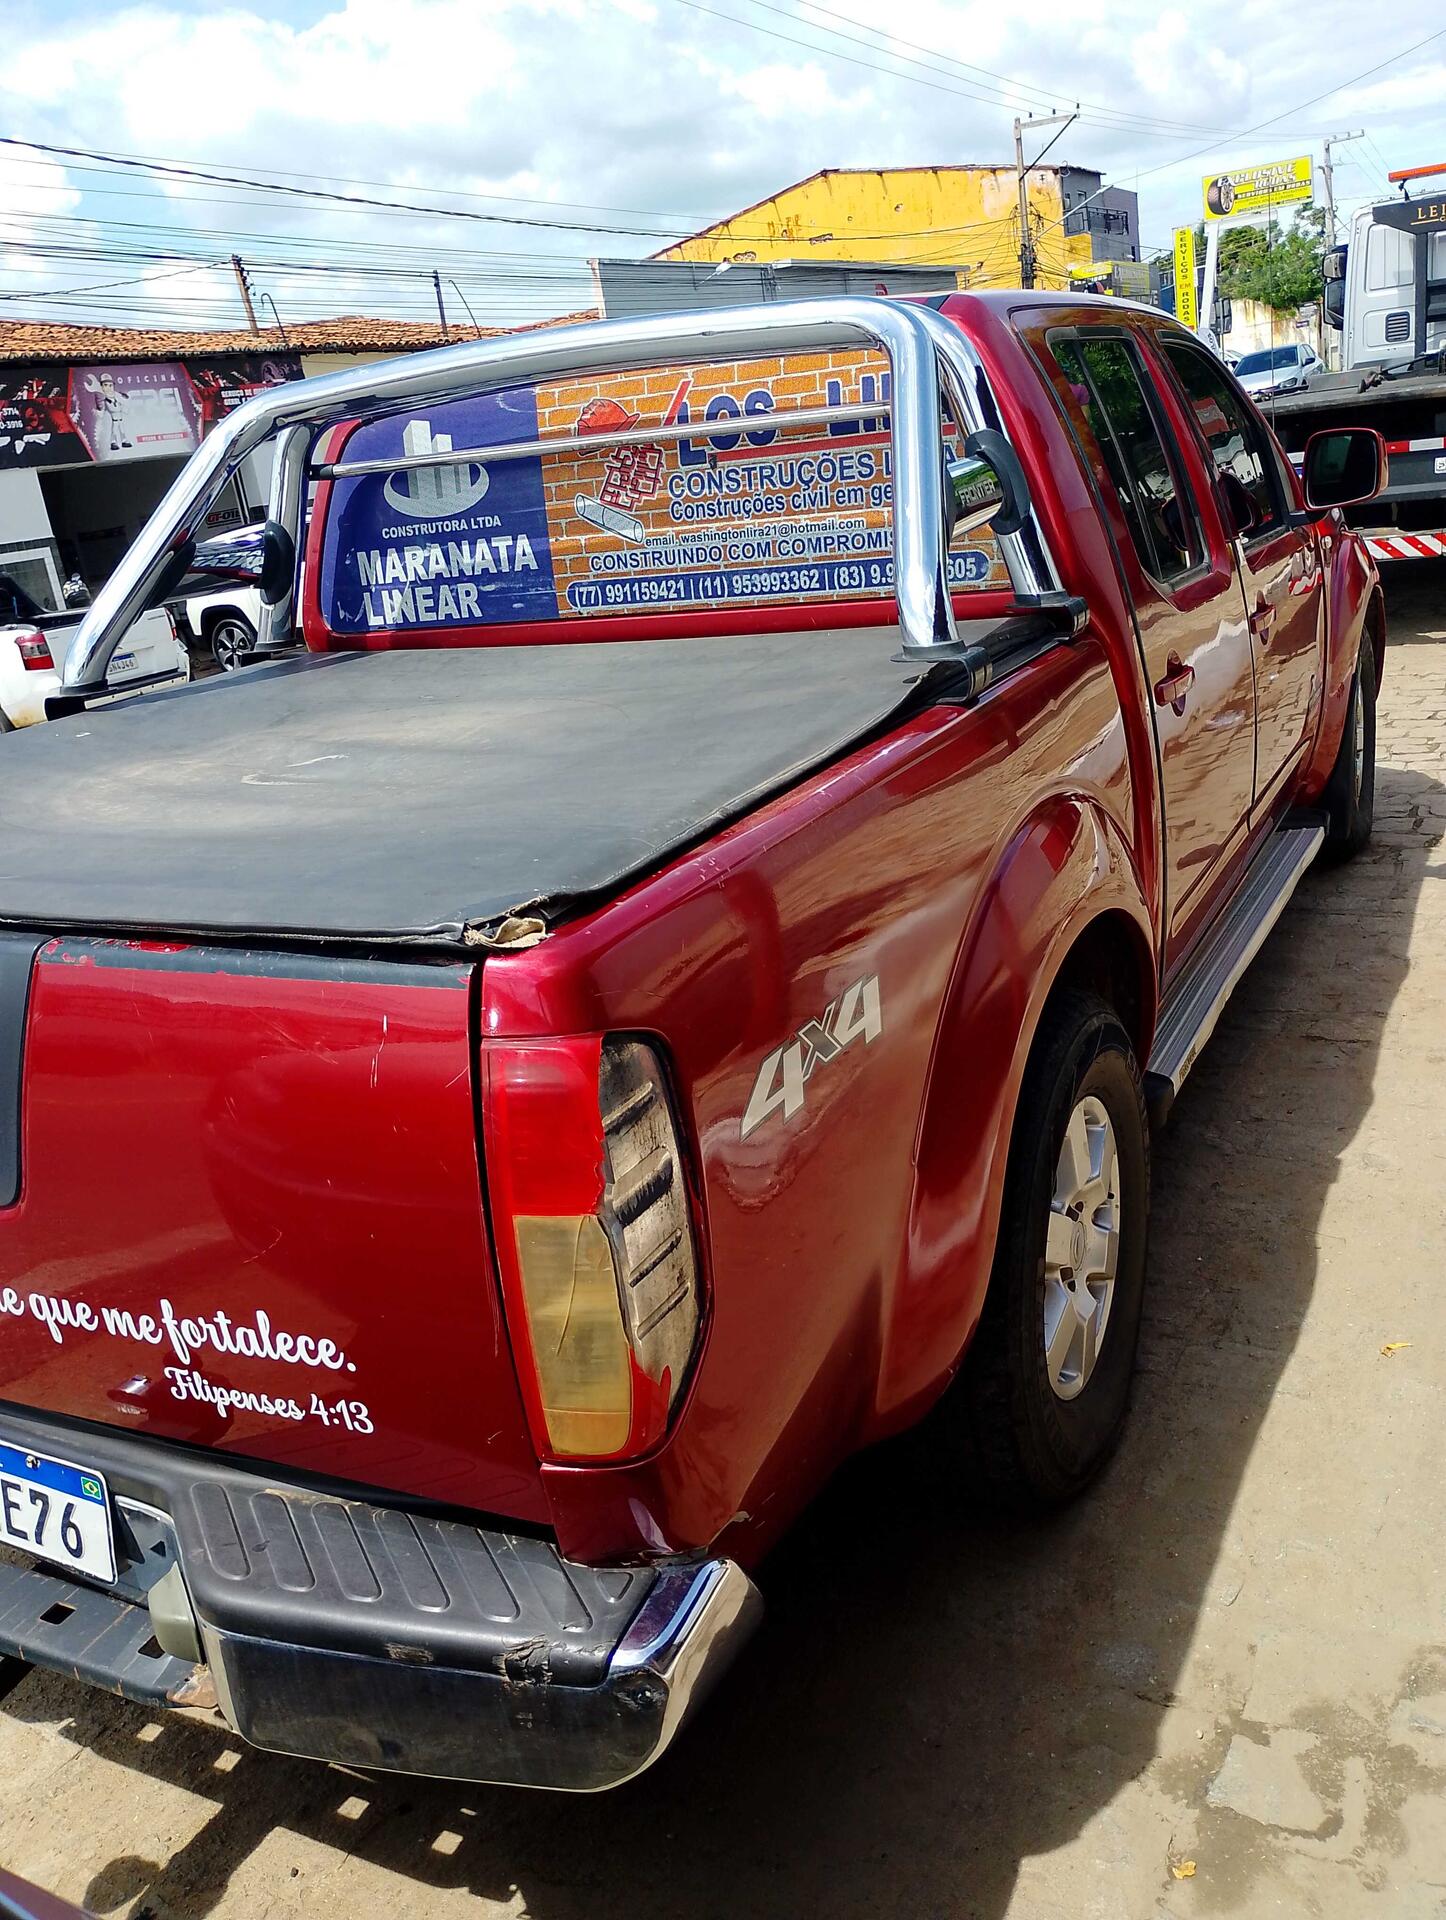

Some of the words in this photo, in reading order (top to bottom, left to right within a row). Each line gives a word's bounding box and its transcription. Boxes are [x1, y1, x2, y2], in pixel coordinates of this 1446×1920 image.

[1417, 203, 1446, 220] LEI
[117, 374, 176, 384] OFICINA
[668, 451, 875, 500] CONSTRUÇÕES
[958, 478, 996, 506] FRONTIER
[670, 495, 786, 522] Construções
[791, 483, 830, 509] civil
[835, 489, 866, 504] em
[381, 519, 468, 540] CONSTRUTORA
[471, 515, 502, 529] LTDA
[681, 518, 866, 542] washingtonlira21@hotmail.com
[357, 533, 539, 587] MARANATA
[590, 545, 724, 572] CONSTRUINDO
[728, 540, 772, 562] COM
[363, 583, 483, 627] LINEAR
[574, 584, 602, 609] (77)
[606, 579, 687, 604] 991159421
[699, 574, 729, 600] (11)
[732, 568, 820, 595] 953993362
[834, 565, 866, 589] (83)
[0, 1287, 25, 1317] e
[29, 1292, 98, 1344] que
[101, 1307, 163, 1345] me
[160, 1298, 357, 1373] fortalece.
[164, 1366, 305, 1418] Filipenses
[310, 1393, 374, 1434] 4:13
[0, 1478, 84, 1560] E76
